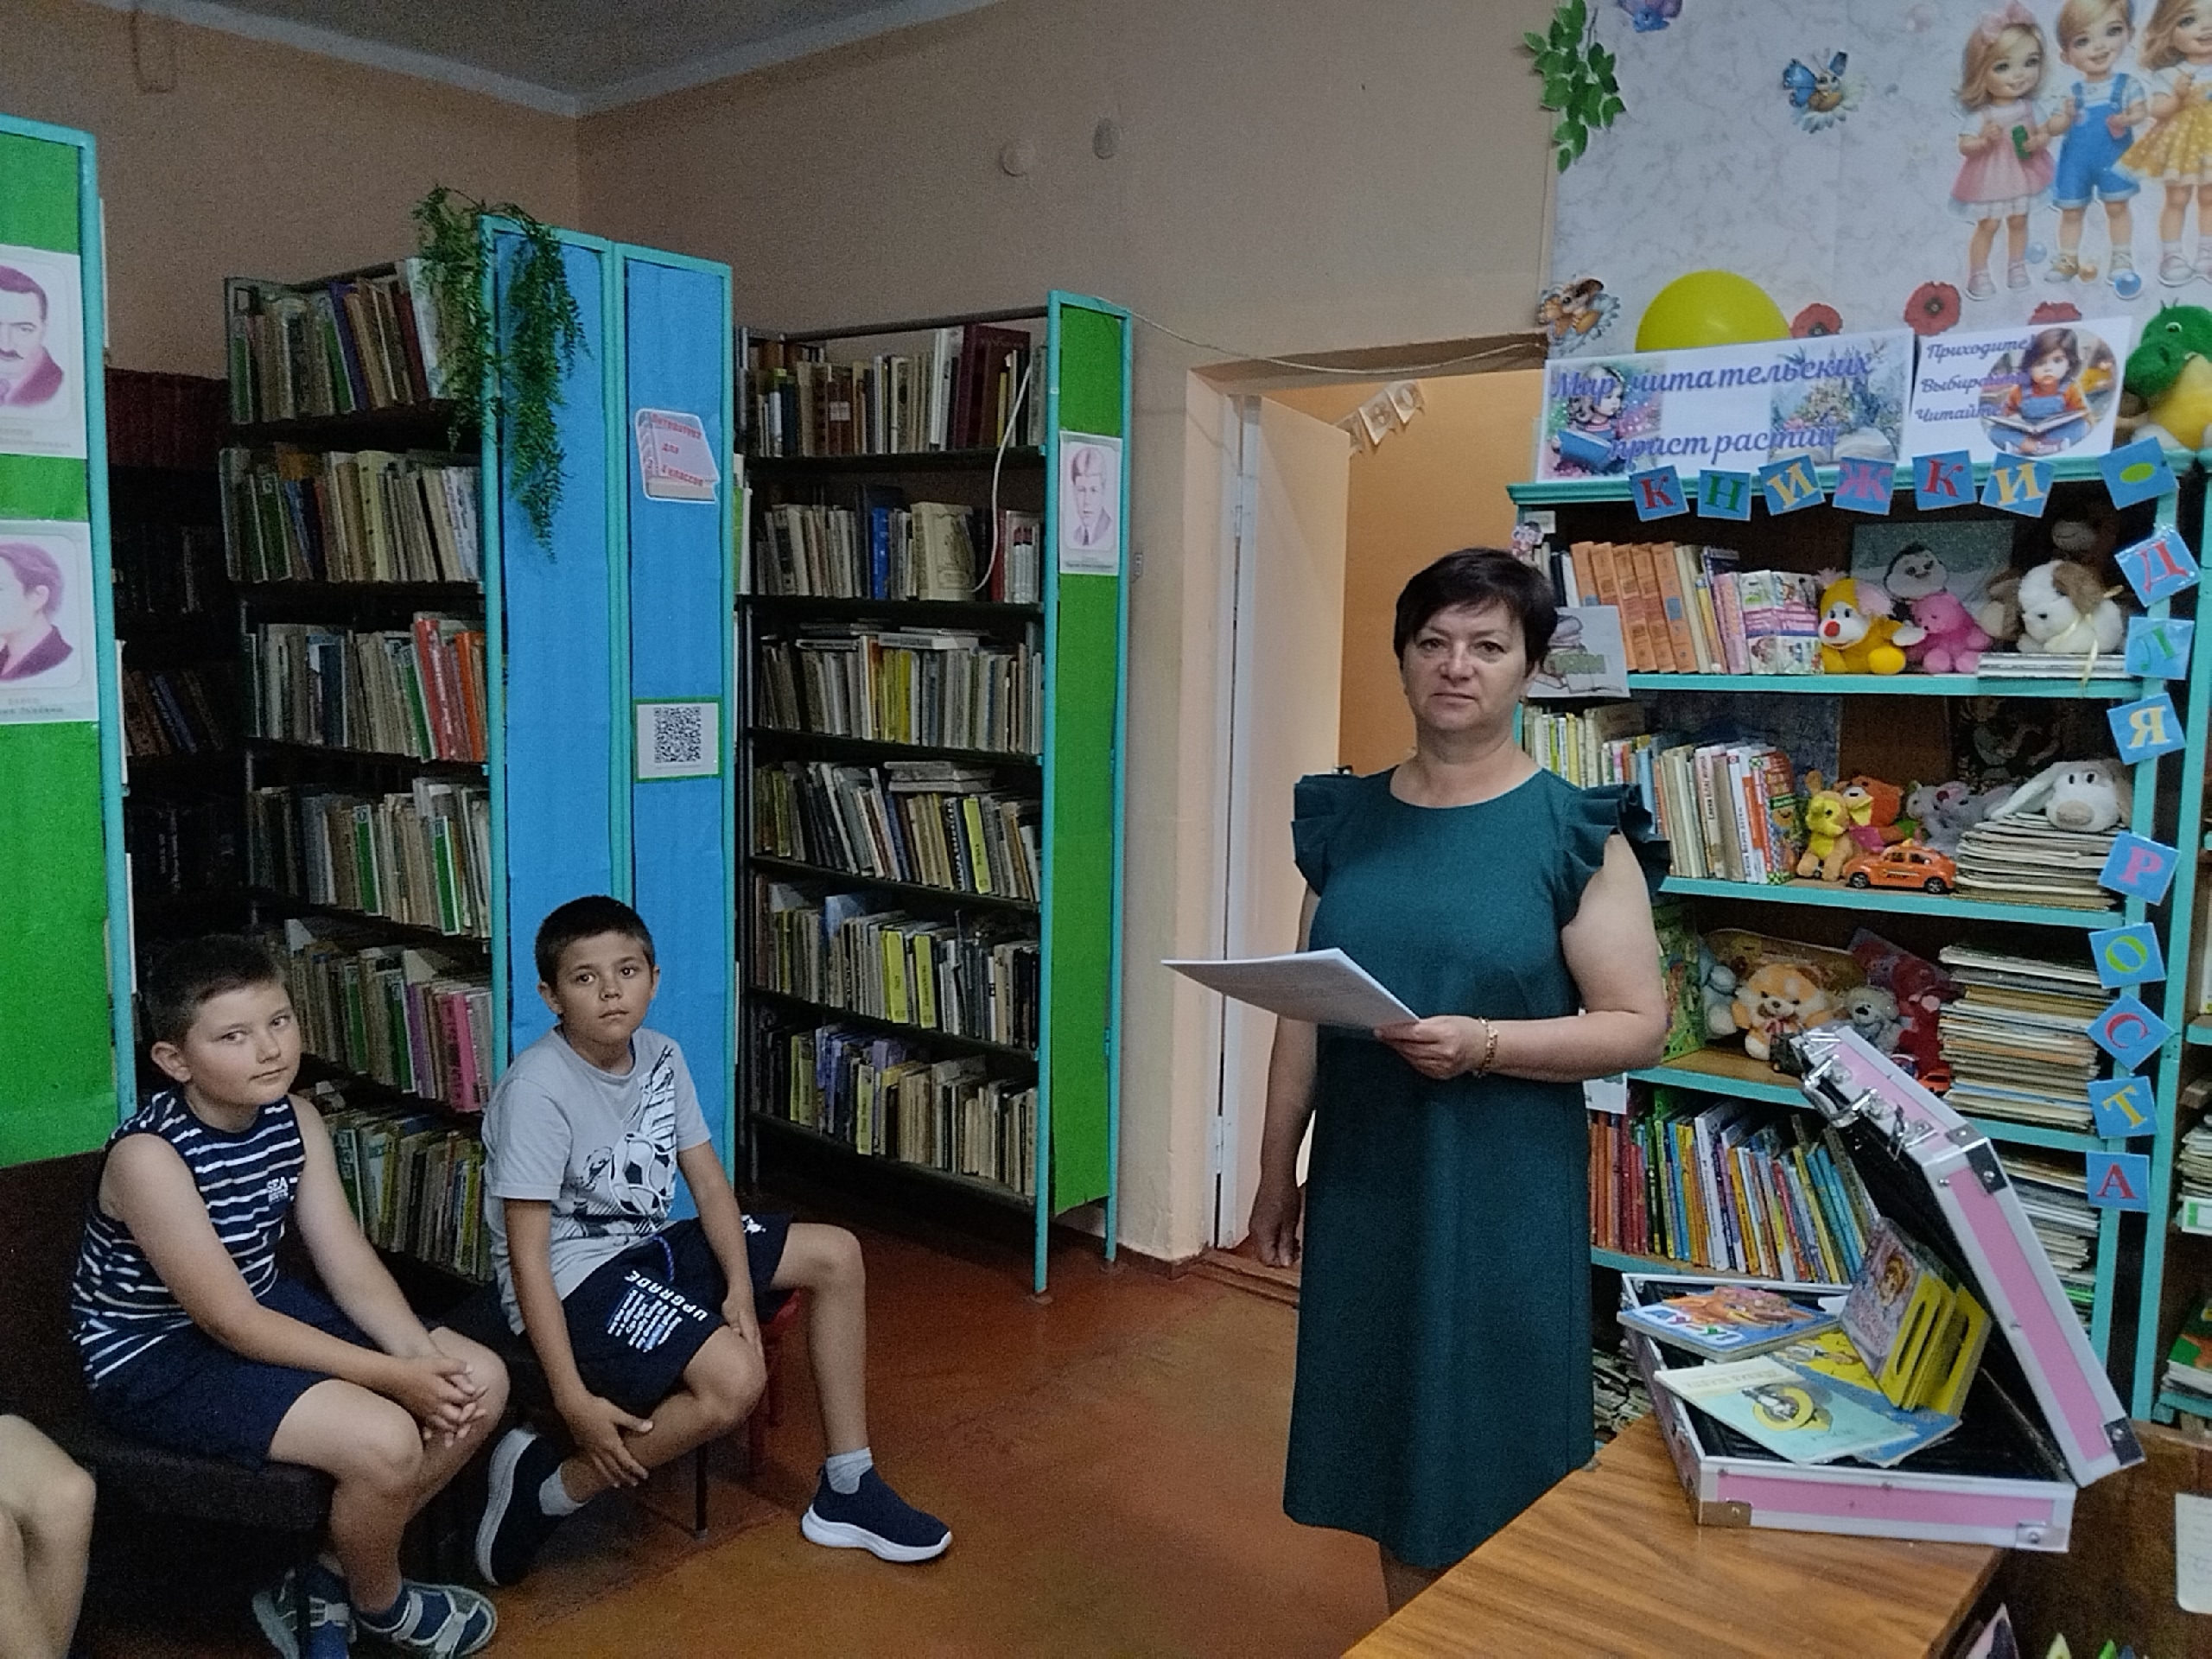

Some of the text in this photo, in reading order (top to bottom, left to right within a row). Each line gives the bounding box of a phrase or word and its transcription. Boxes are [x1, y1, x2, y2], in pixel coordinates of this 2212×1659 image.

[1631, 353, 1875, 391] читательских
[1640, 459, 2044, 511] КНИЖКИ
[2096, 539, 2188, 1199] ДЛЯ РОСТА
[624, 1269, 709, 1322] UPGRADE
